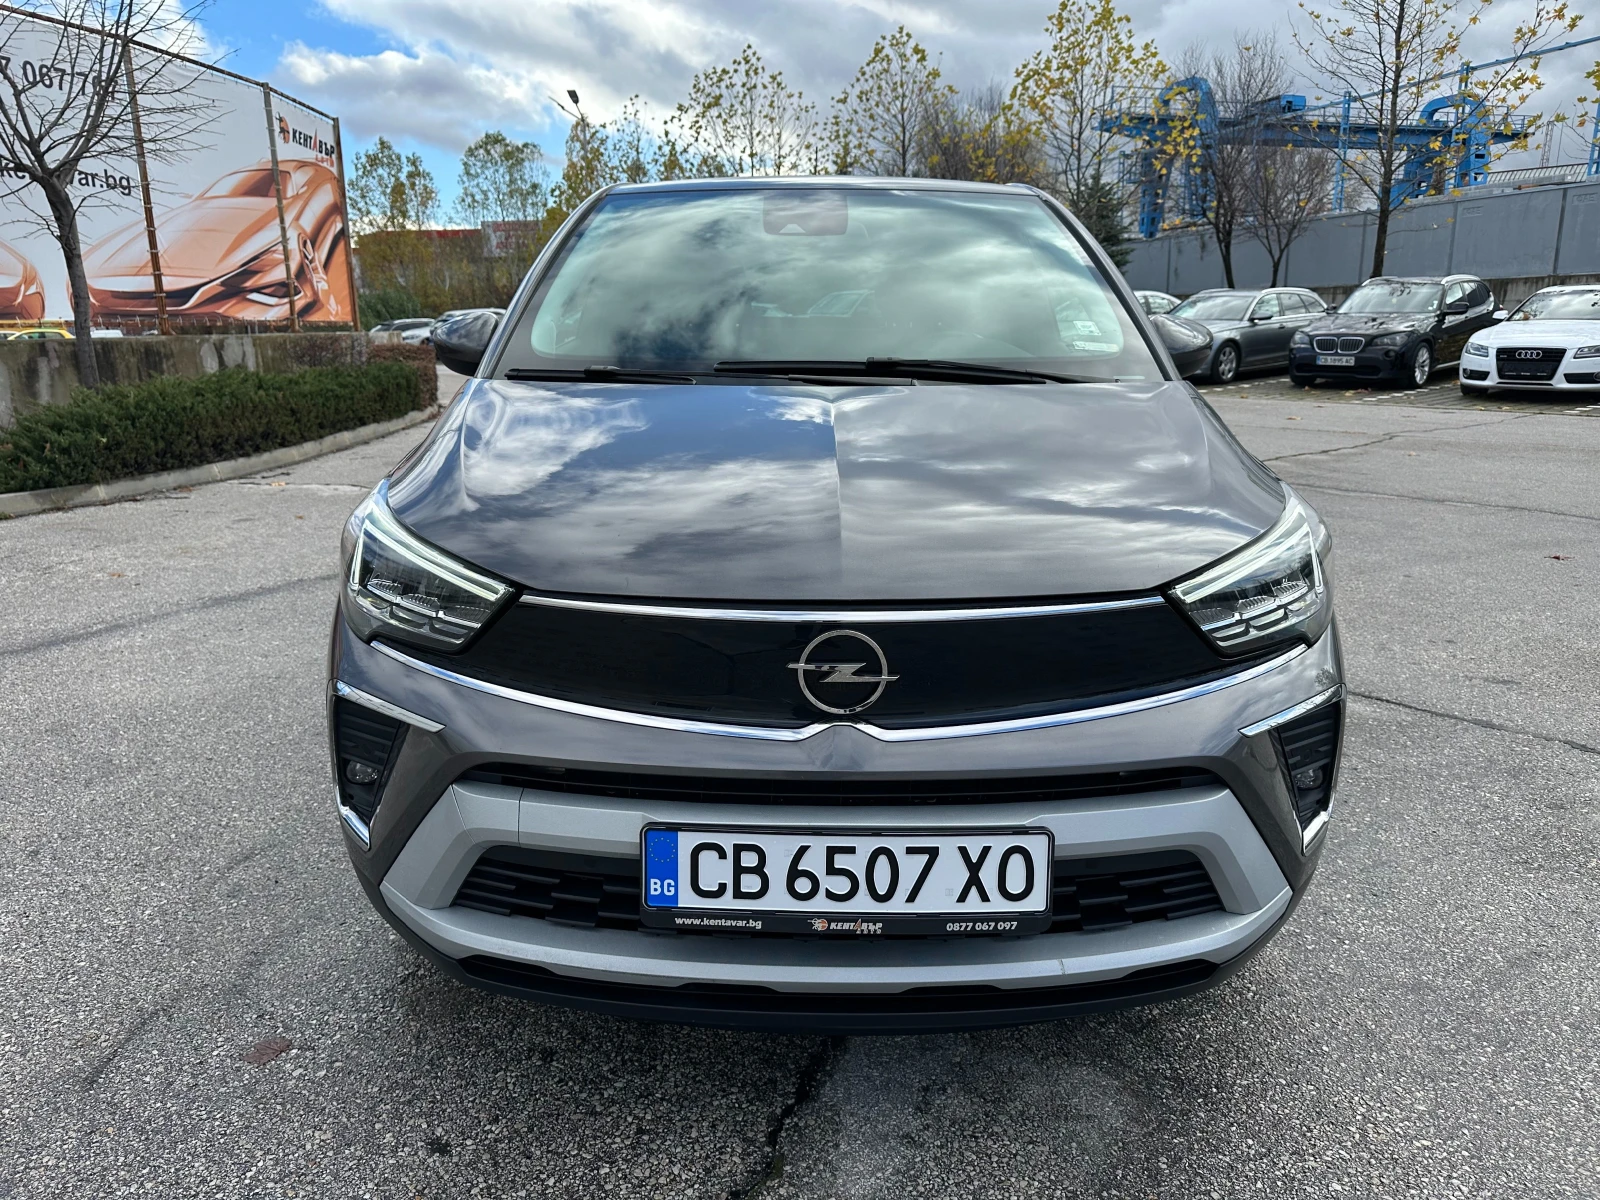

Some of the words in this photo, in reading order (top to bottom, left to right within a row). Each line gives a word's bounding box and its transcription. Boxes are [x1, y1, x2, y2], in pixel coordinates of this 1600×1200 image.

[689, 841, 770, 900] CB
[785, 844, 940, 903] 6507
[955, 845, 1035, 903] XO
[650, 878, 676, 896] BG
[674, 916, 762, 930] www.kentavar.bg
[946, 922, 973, 932] 0877
[975, 922, 995, 931] 067
[997, 921, 1018, 931] 097
